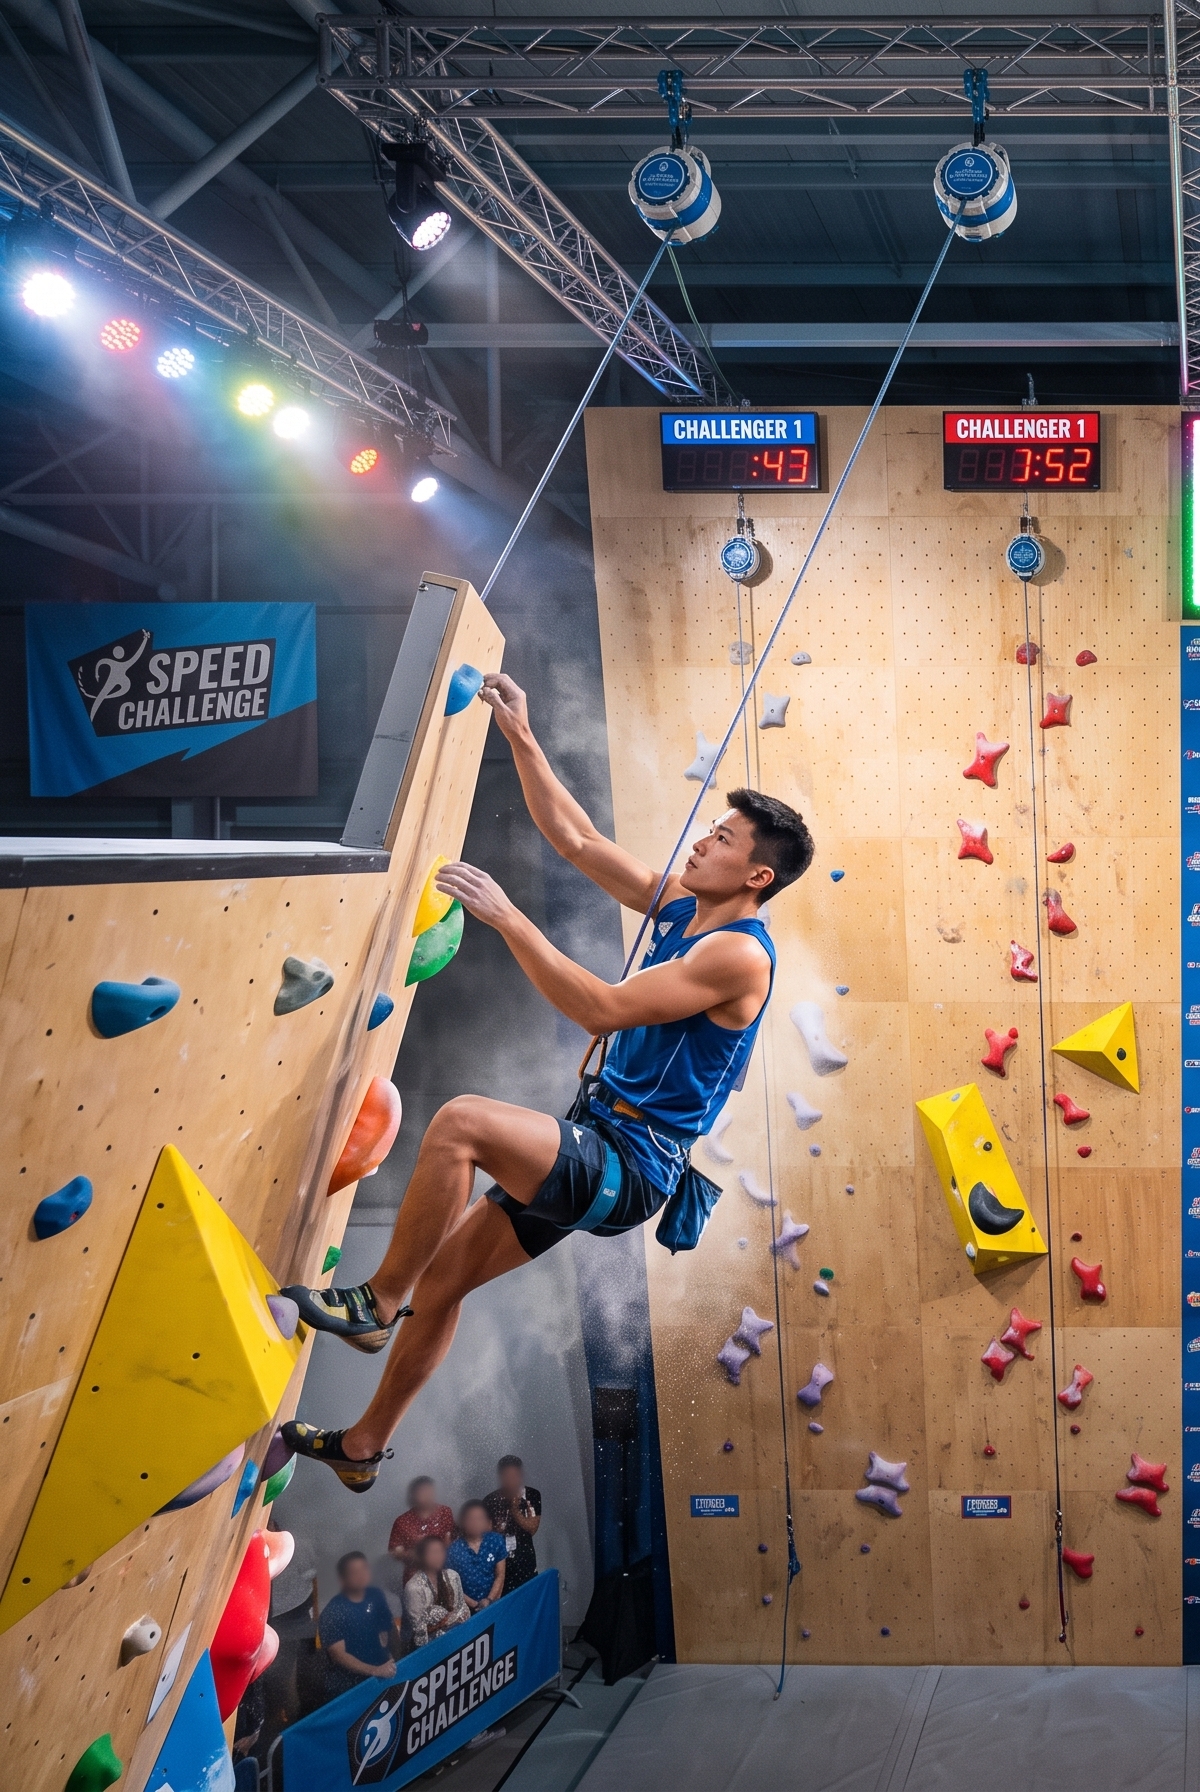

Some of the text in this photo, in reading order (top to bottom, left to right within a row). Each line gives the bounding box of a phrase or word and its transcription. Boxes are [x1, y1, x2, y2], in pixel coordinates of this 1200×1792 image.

[674, 419, 801, 439] CHALLENGER 1
[956, 418, 1085, 439] CHALLENGER 1
[146, 643, 271, 695] SPEED
[118, 687, 267, 730] CHALLENGE
[410, 1632, 490, 1719] SPEED
[406, 1651, 515, 1755] CHALLENGE
